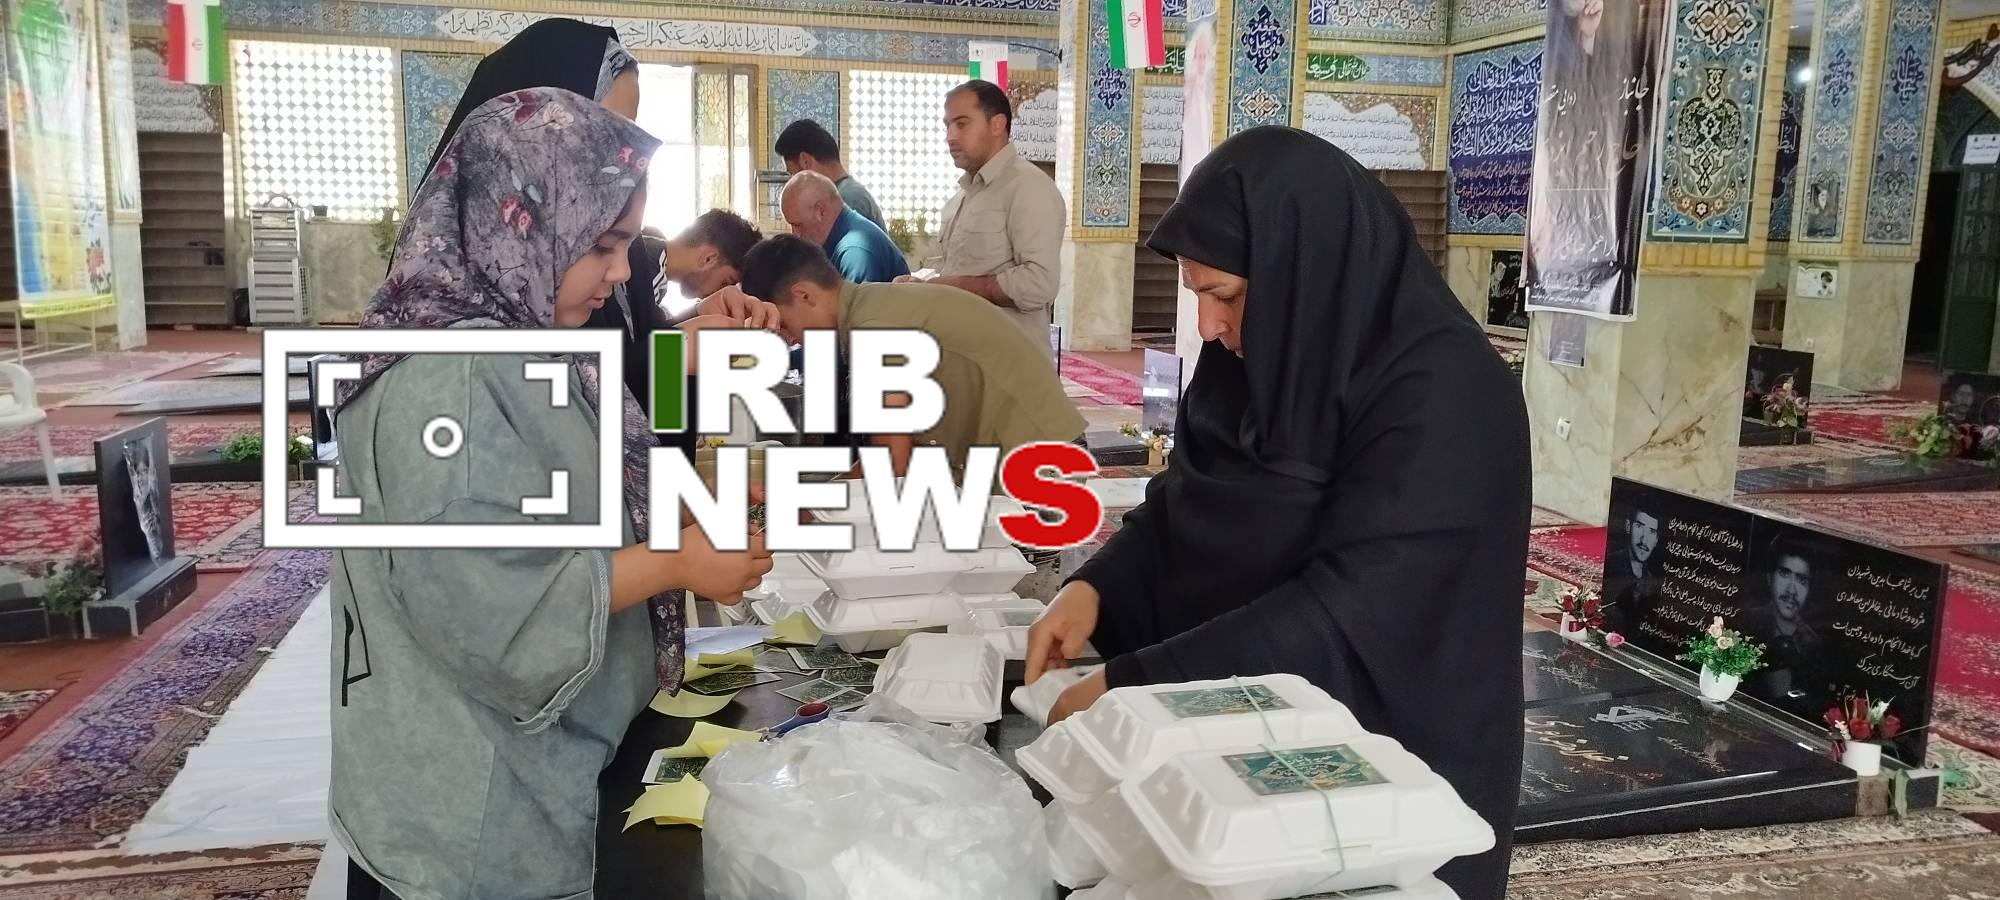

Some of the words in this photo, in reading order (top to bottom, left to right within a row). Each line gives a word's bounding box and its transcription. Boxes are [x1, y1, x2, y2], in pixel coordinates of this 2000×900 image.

[1848, 565, 1871, 579] شهیدان
[1914, 586, 1930, 600] پس
[1913, 644, 1928, 658] که
[1904, 675, 1922, 690] آن
